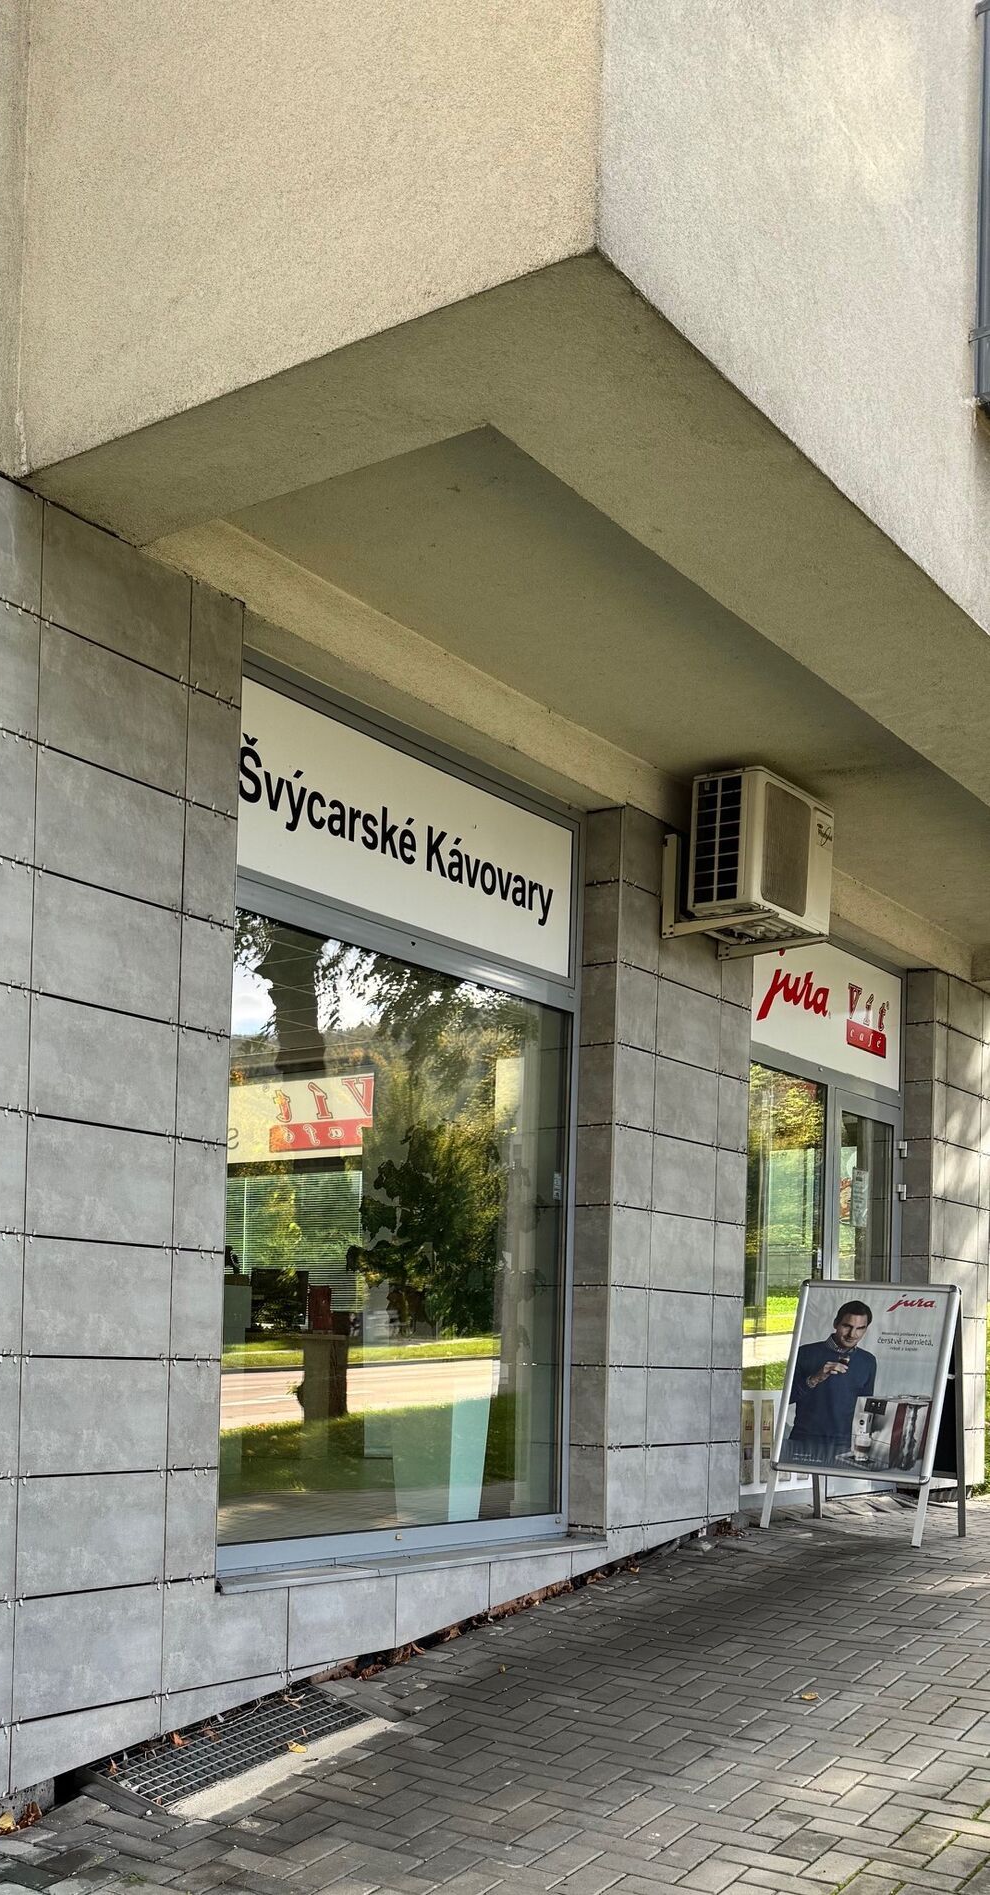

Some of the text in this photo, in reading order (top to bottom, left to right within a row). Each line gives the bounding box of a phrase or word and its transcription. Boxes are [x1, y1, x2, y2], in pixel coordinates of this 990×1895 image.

[239, 733, 554, 927] Švýcarské Kávovary
[756, 948, 830, 1021] jura
[849, 1029, 882, 1052] café
[886, 1294, 936, 1312] jura
